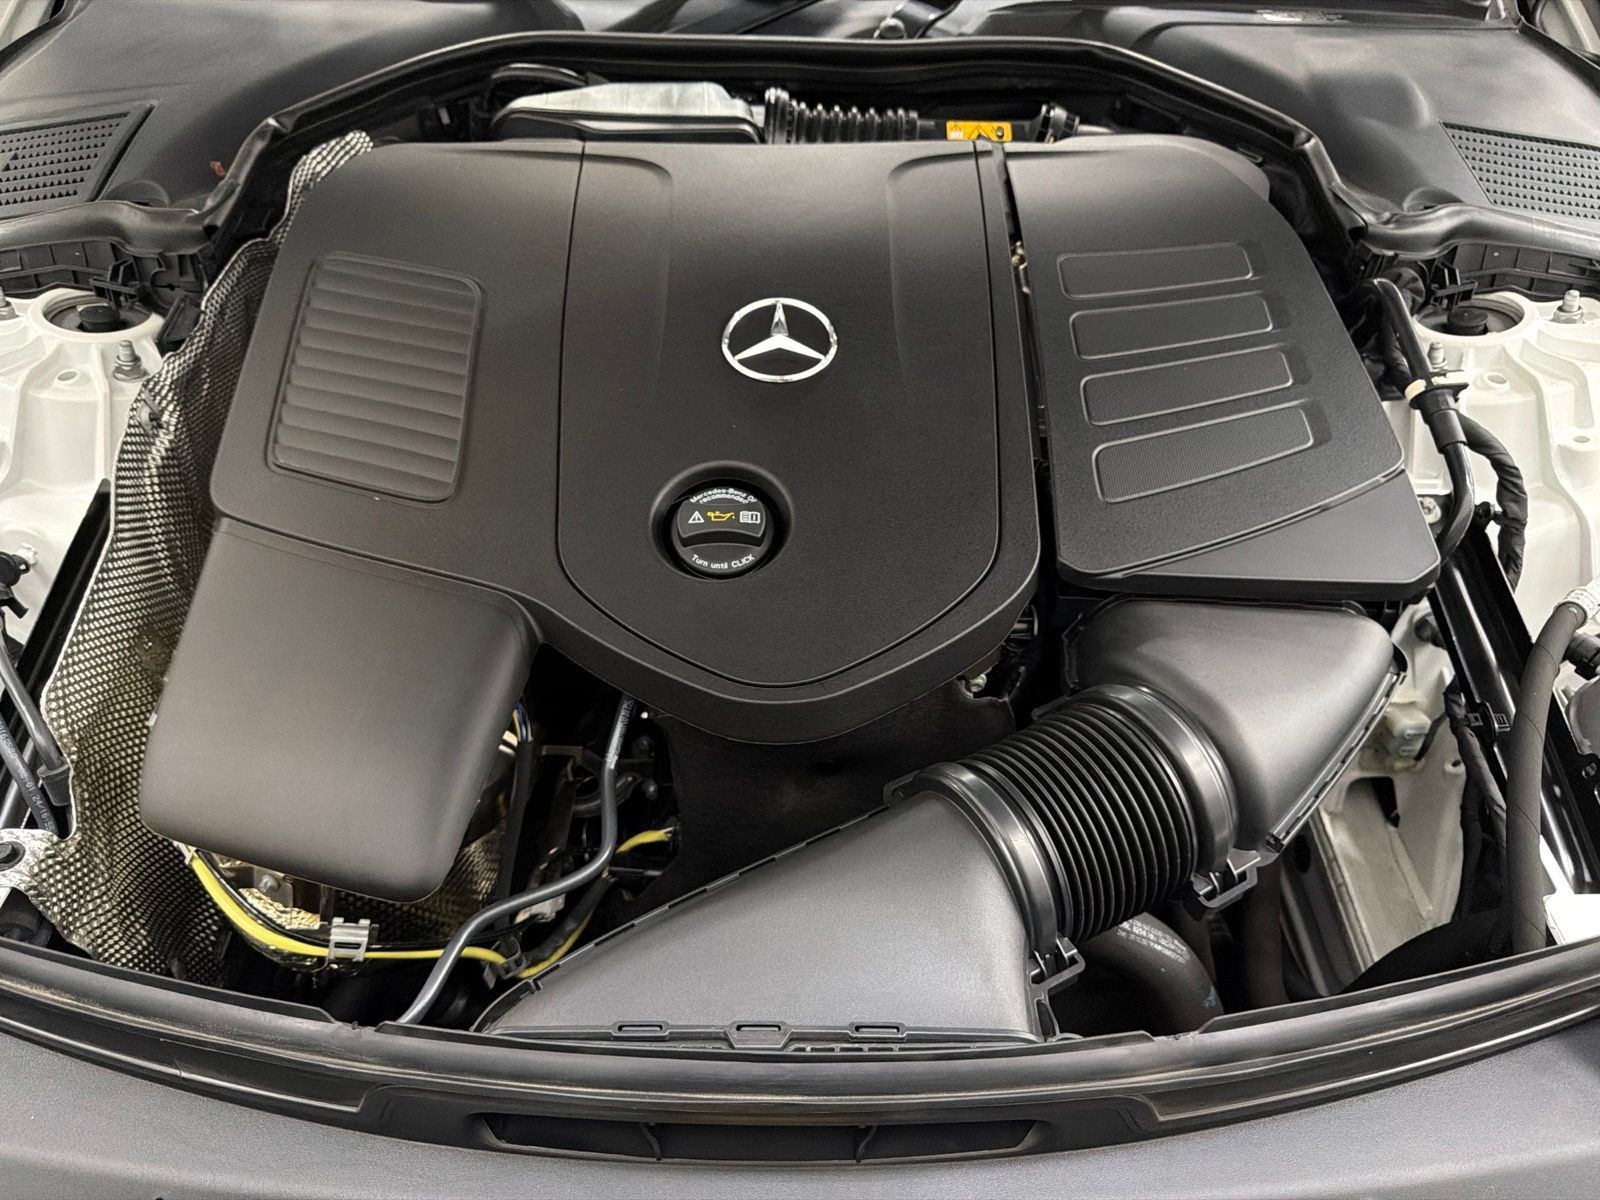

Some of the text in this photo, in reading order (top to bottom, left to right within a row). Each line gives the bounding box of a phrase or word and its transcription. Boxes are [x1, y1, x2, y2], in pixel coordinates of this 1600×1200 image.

[690, 488, 746, 503] Mercedes-Benz
[699, 493, 749, 504] recommended
[691, 554, 708, 567] Turn
[731, 554, 755, 568] CLICK
